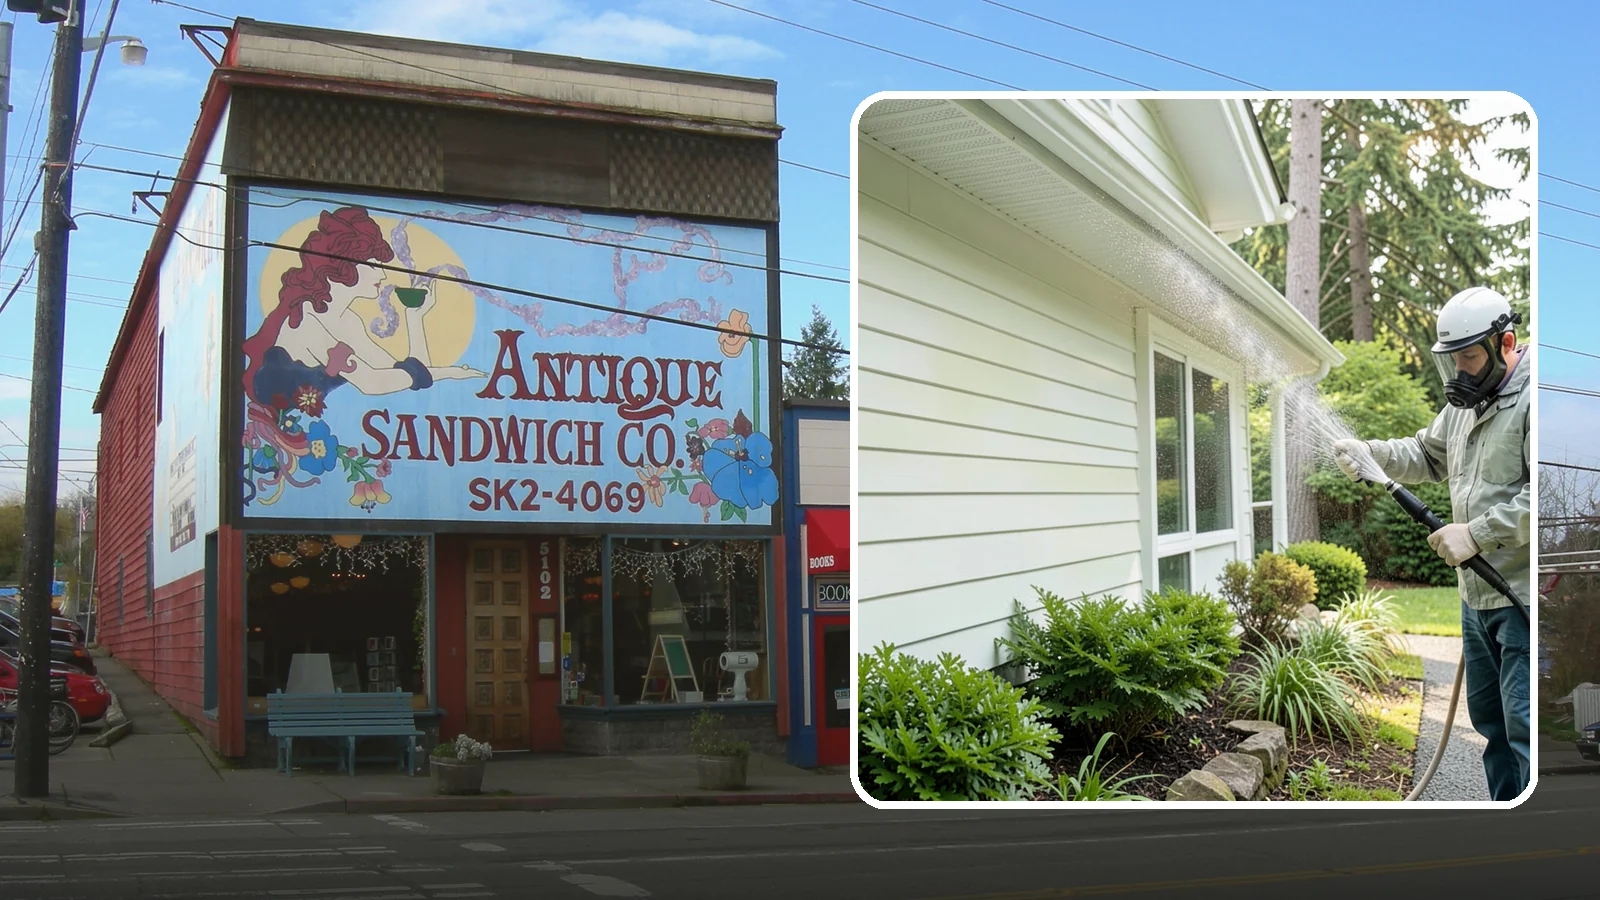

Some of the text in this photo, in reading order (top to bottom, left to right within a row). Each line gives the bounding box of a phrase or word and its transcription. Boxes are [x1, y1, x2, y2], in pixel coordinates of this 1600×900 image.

[476, 329, 723, 421] ANTIQUE
[361, 408, 684, 469] SANDWICH CO.
[468, 477, 645, 513] SK2-4069
[540, 541, 551, 600] 5102
[809, 555, 834, 569] BOOKS
